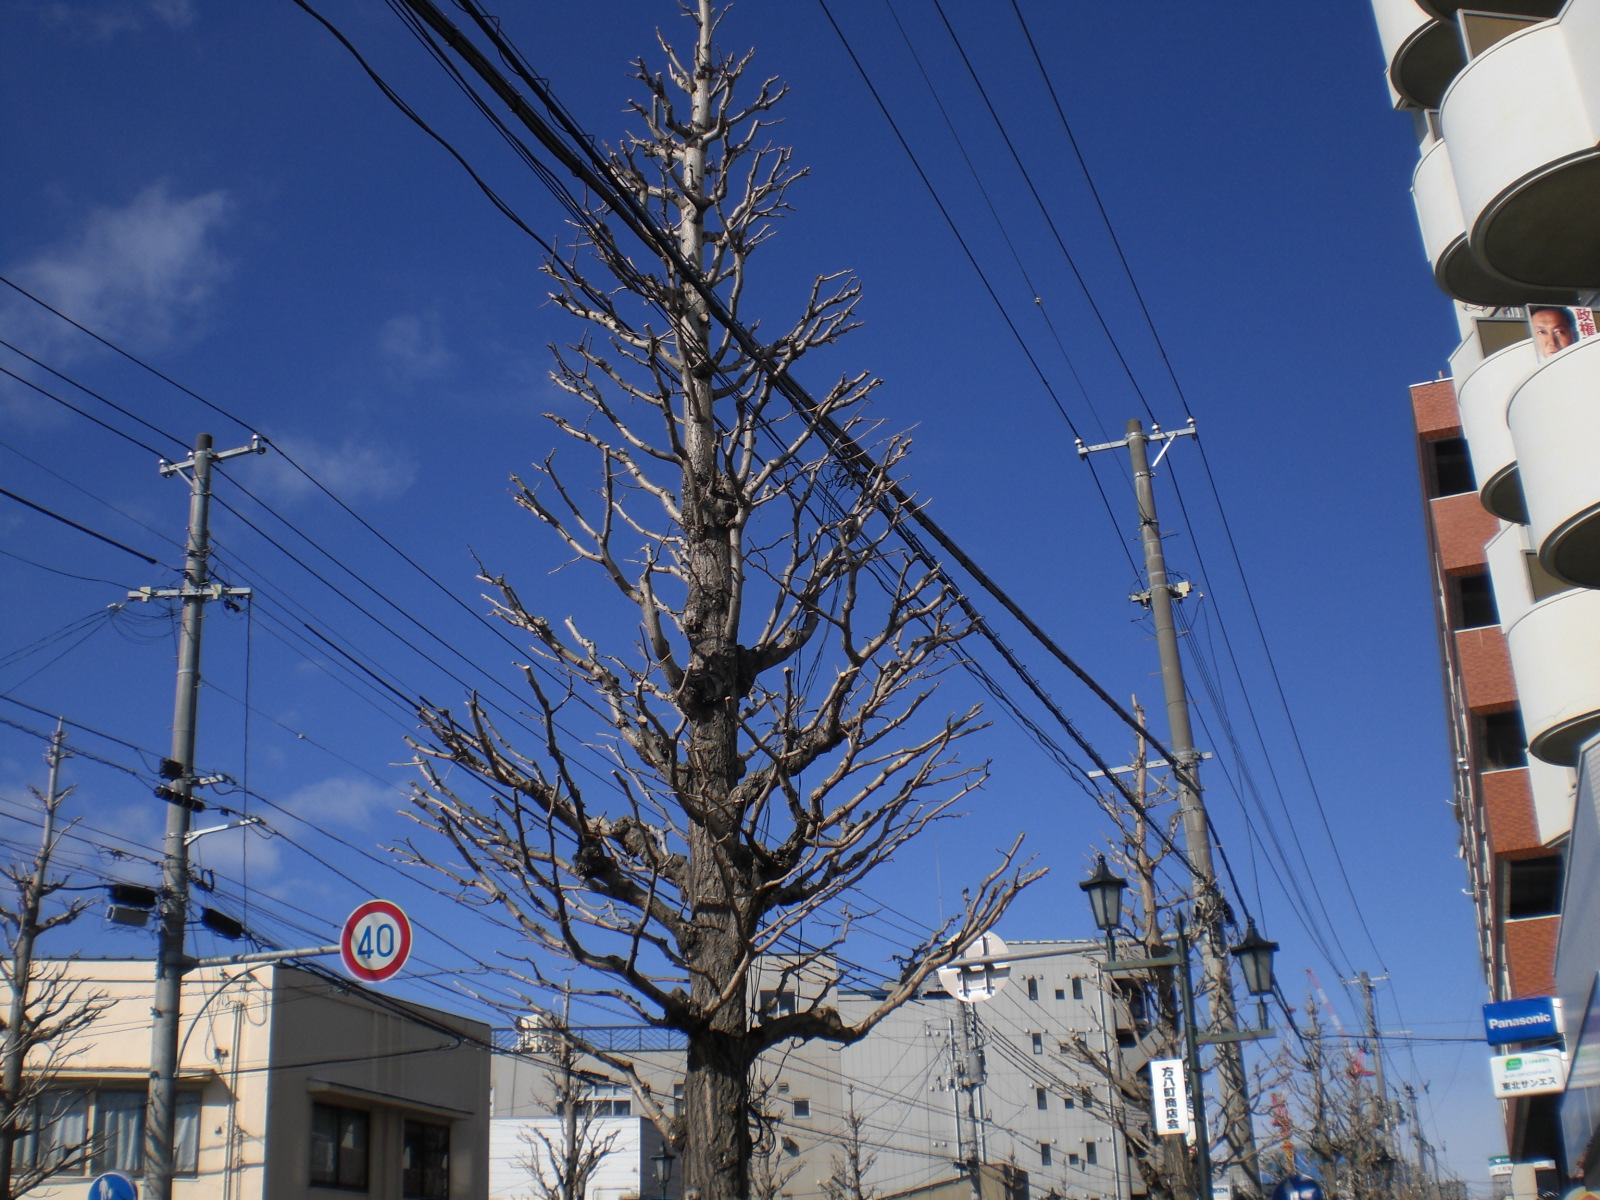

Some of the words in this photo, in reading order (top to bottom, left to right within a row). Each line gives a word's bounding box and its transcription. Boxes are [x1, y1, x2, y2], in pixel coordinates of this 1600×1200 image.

[1575, 308, 1594, 339] 政権
[357, 923, 395, 959] 40
[1488, 1012, 1551, 1030] Panasonic
[1161, 1066, 1180, 1130] 方八町商店会
[1502, 1076, 1557, 1092] 東北サンエス
